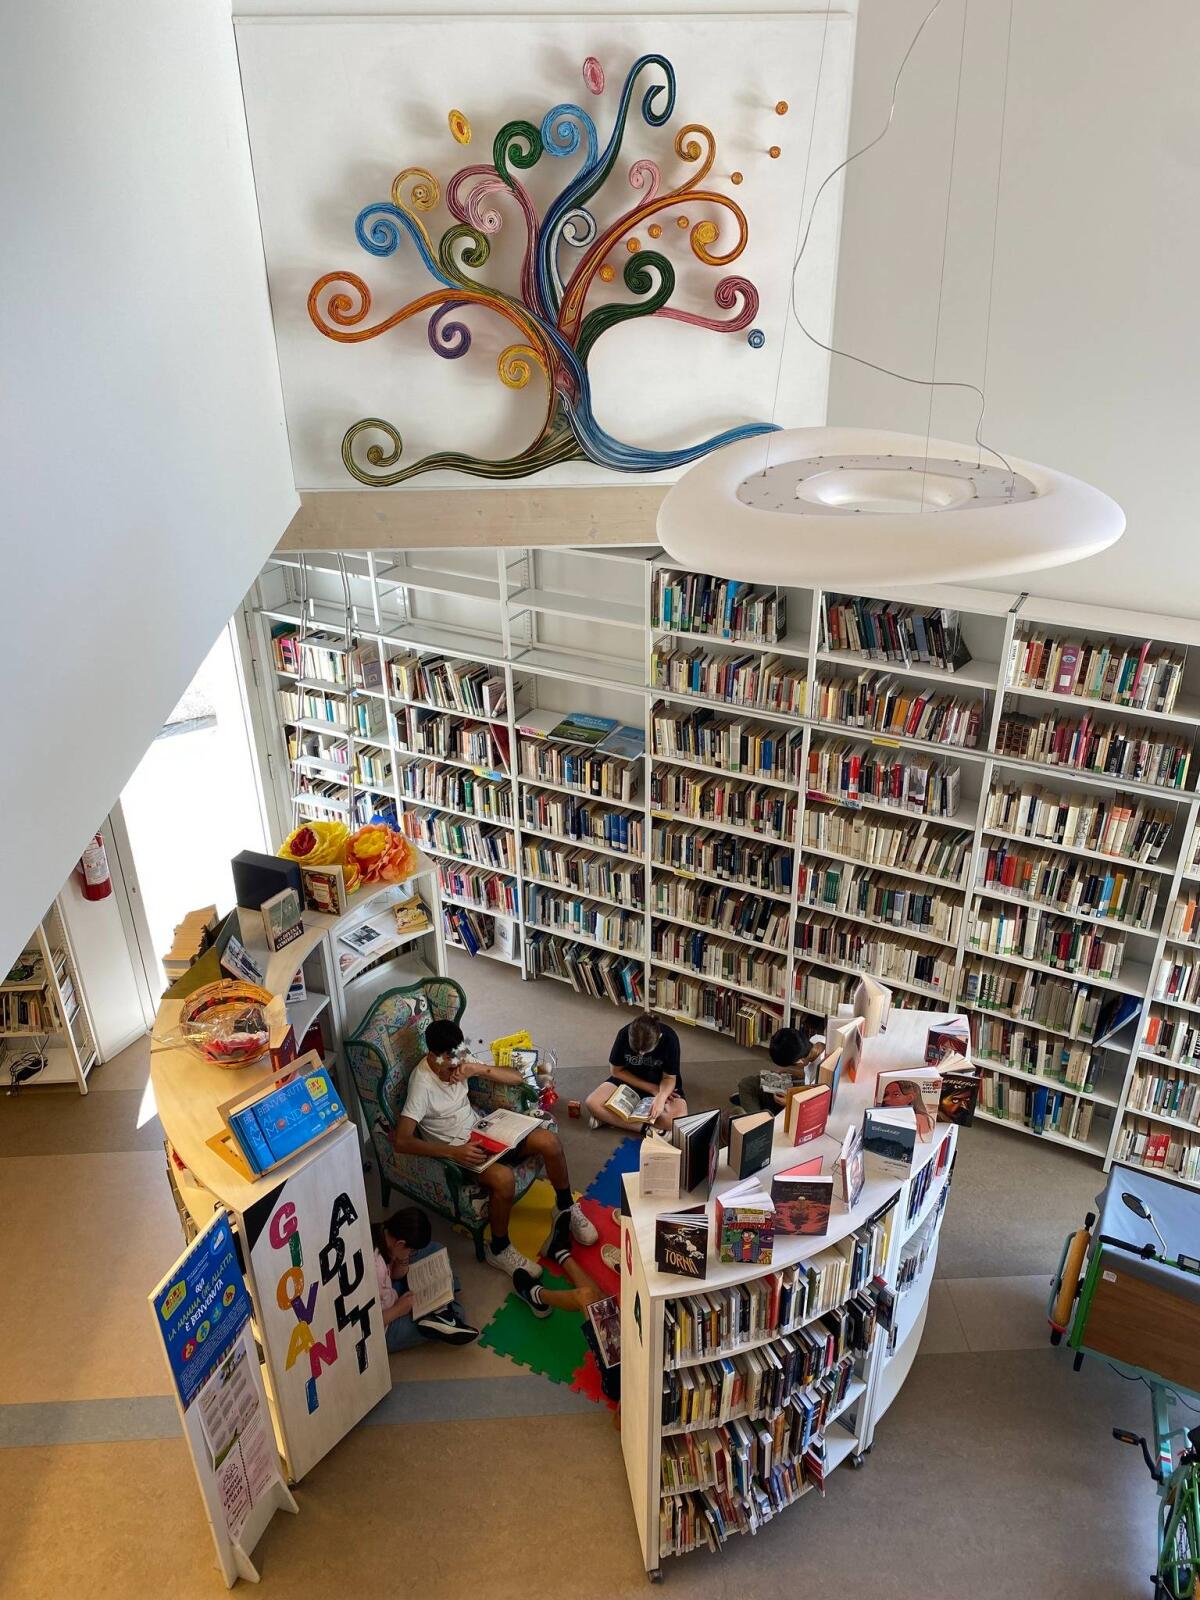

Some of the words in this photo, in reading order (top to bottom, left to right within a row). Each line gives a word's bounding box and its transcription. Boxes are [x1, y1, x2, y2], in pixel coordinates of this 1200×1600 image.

[257, 1082, 304, 1117] BENVENUTI
[168, 1328, 177, 1342] LA
[211, 1252, 234, 1286] ALLATTA
[190, 1279, 224, 1327] BENVENUTA
[195, 1278, 205, 1294] QUI
[269, 1201, 338, 1415] GIOVANI
[318, 1192, 376, 1375] ADULTI
